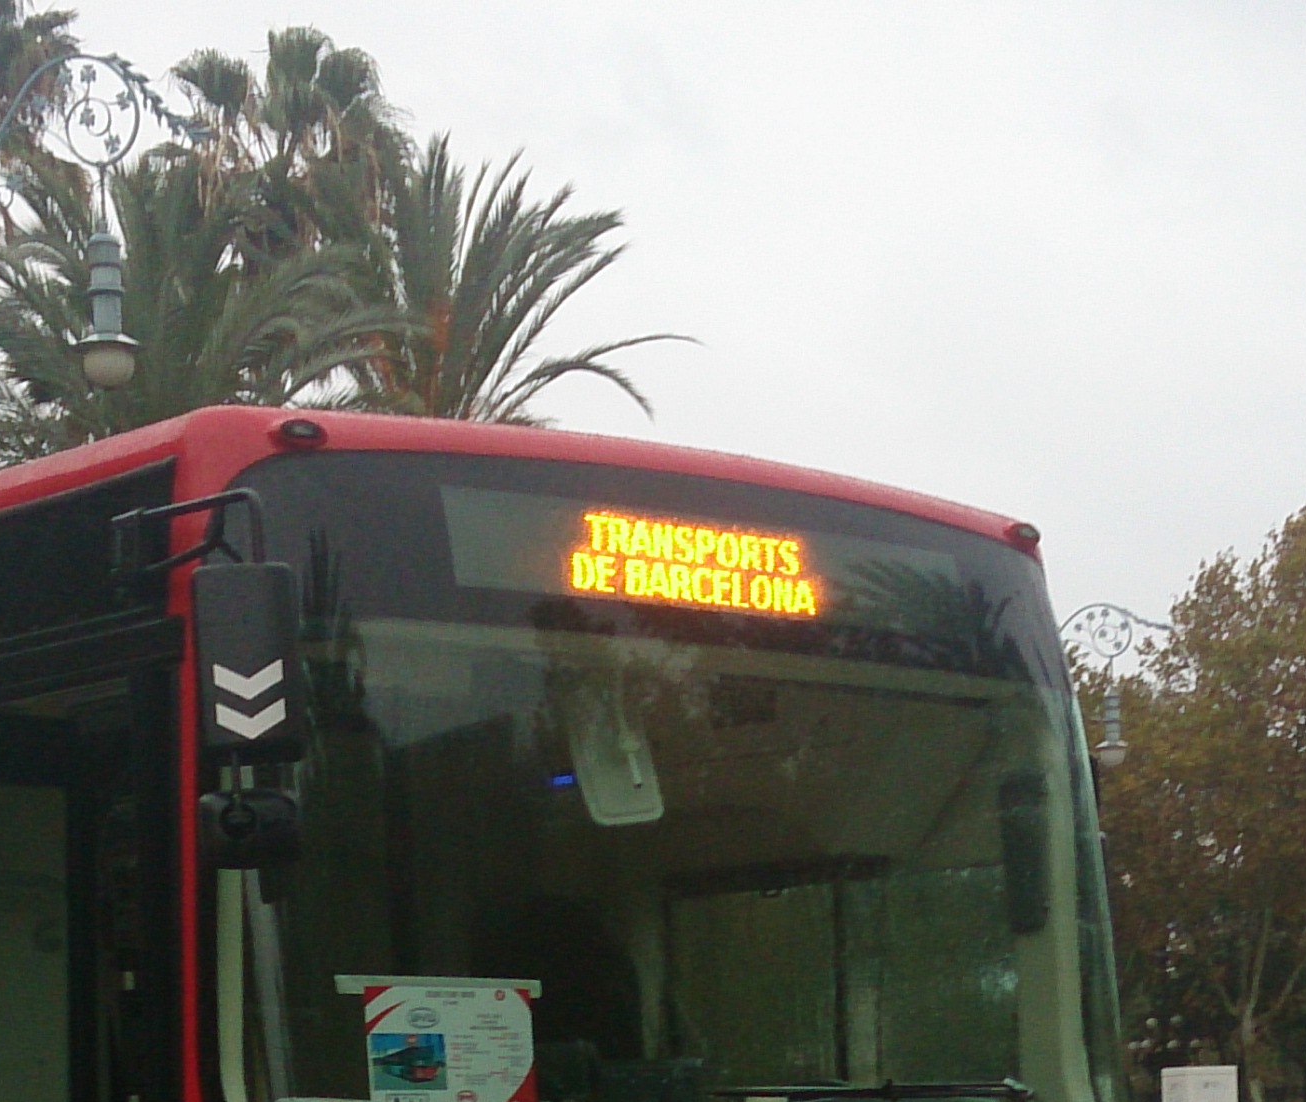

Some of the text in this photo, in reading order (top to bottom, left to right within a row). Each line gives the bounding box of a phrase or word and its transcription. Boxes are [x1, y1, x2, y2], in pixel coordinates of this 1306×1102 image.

[583, 512, 800, 577] TRANSPORTS
[571, 551, 816, 616] DE BARCELONA
